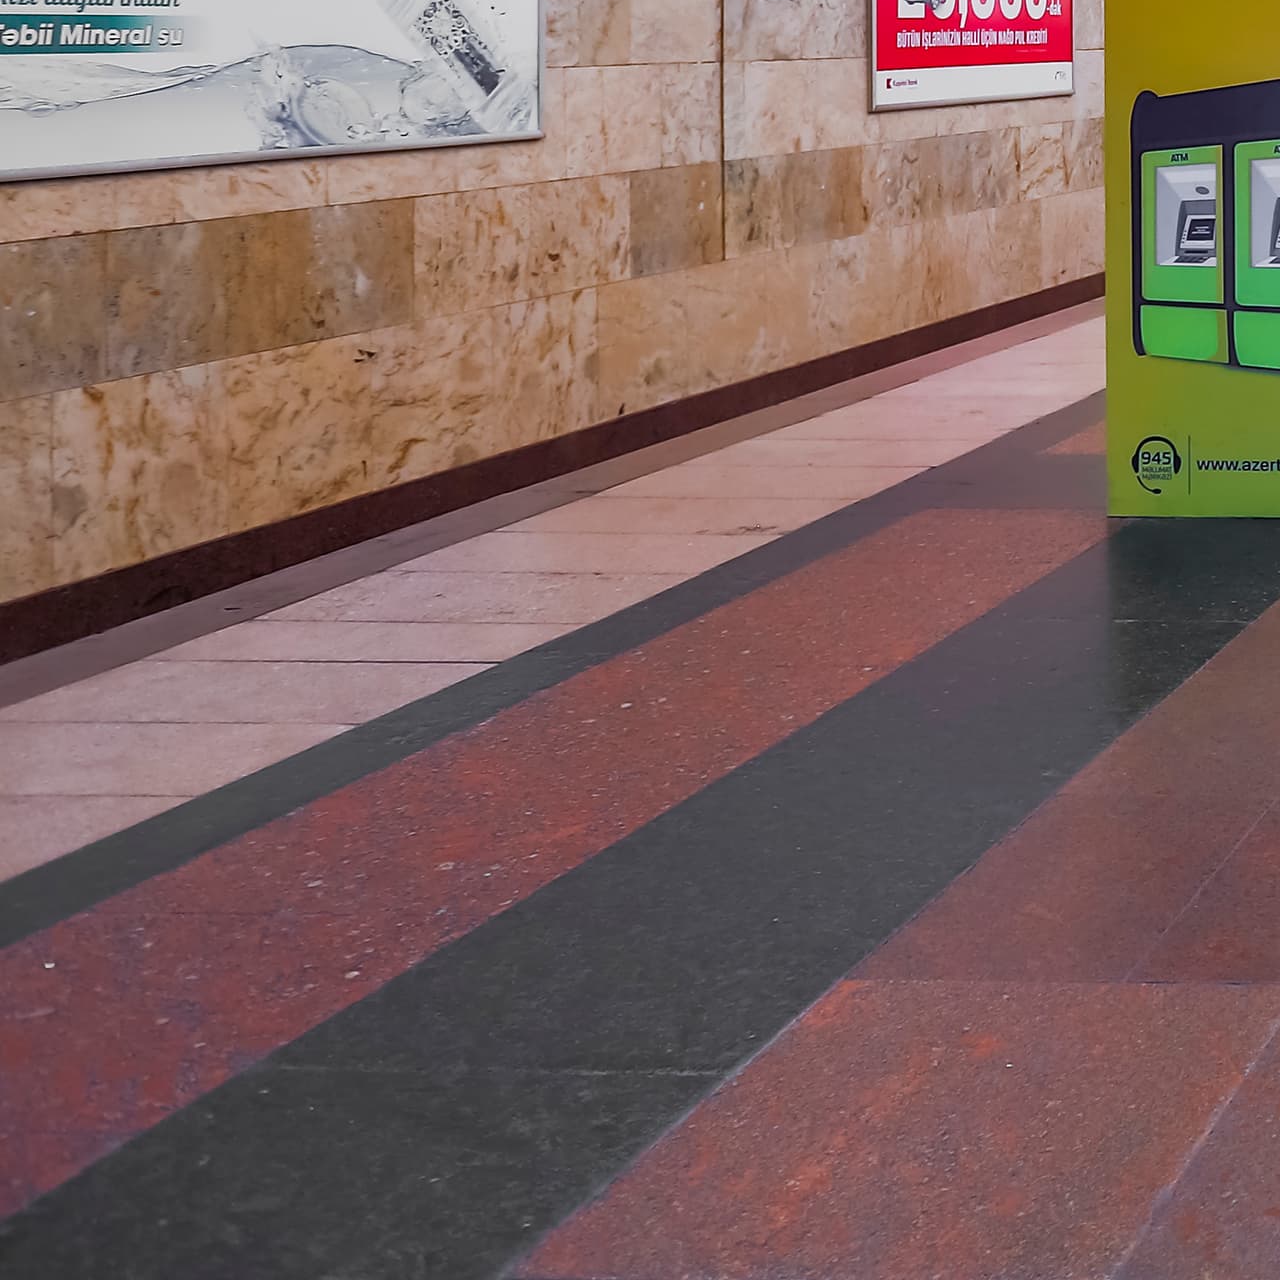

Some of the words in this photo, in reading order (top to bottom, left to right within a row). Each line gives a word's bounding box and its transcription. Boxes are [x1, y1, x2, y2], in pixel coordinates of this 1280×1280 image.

[60, 22, 153, 47] Mineral
[157, 27, 183, 47] su
[1171, 153, 1189, 163] ATM
[1141, 451, 1172, 465] 945
